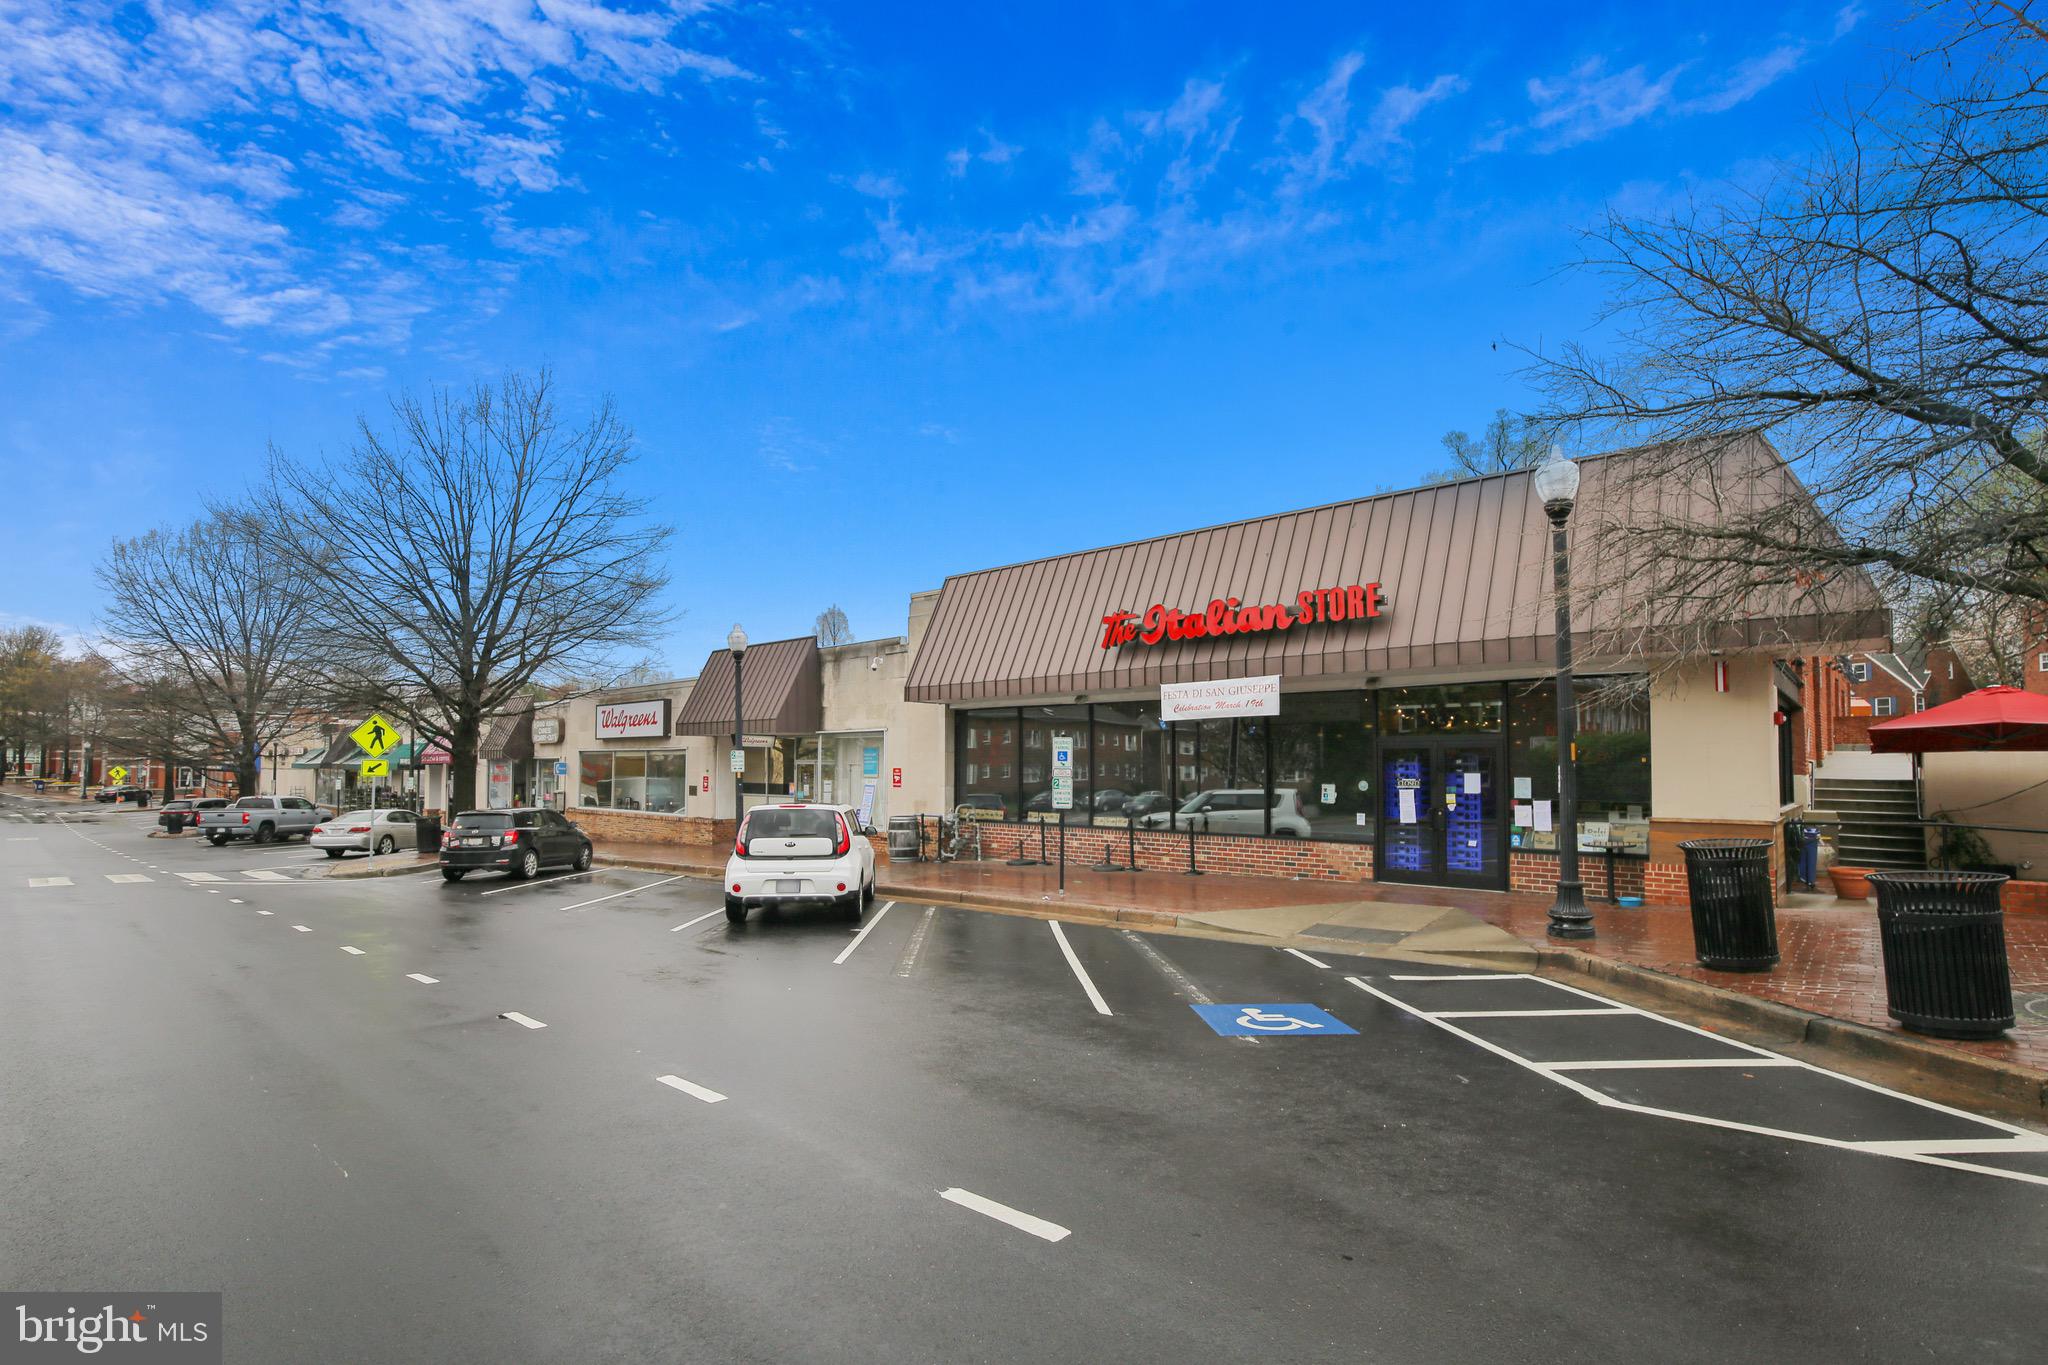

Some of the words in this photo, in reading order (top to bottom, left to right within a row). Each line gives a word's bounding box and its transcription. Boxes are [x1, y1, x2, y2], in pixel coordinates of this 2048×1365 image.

[1101, 609, 1137, 649] The
[1141, 597, 1297, 645] Italian
[1298, 582, 1382, 625] STORE
[1163, 690, 1190, 700] FESTA
[1192, 688, 1203, 698] DI
[1205, 687, 1226, 697] SAN
[1228, 683, 1278, 695] GIUSEPPE
[1173, 703, 1212, 713] Celebration
[1215, 700, 1241, 709] March
[1245, 699, 1265, 708] 19th
[601, 707, 658, 734] Walgreens
